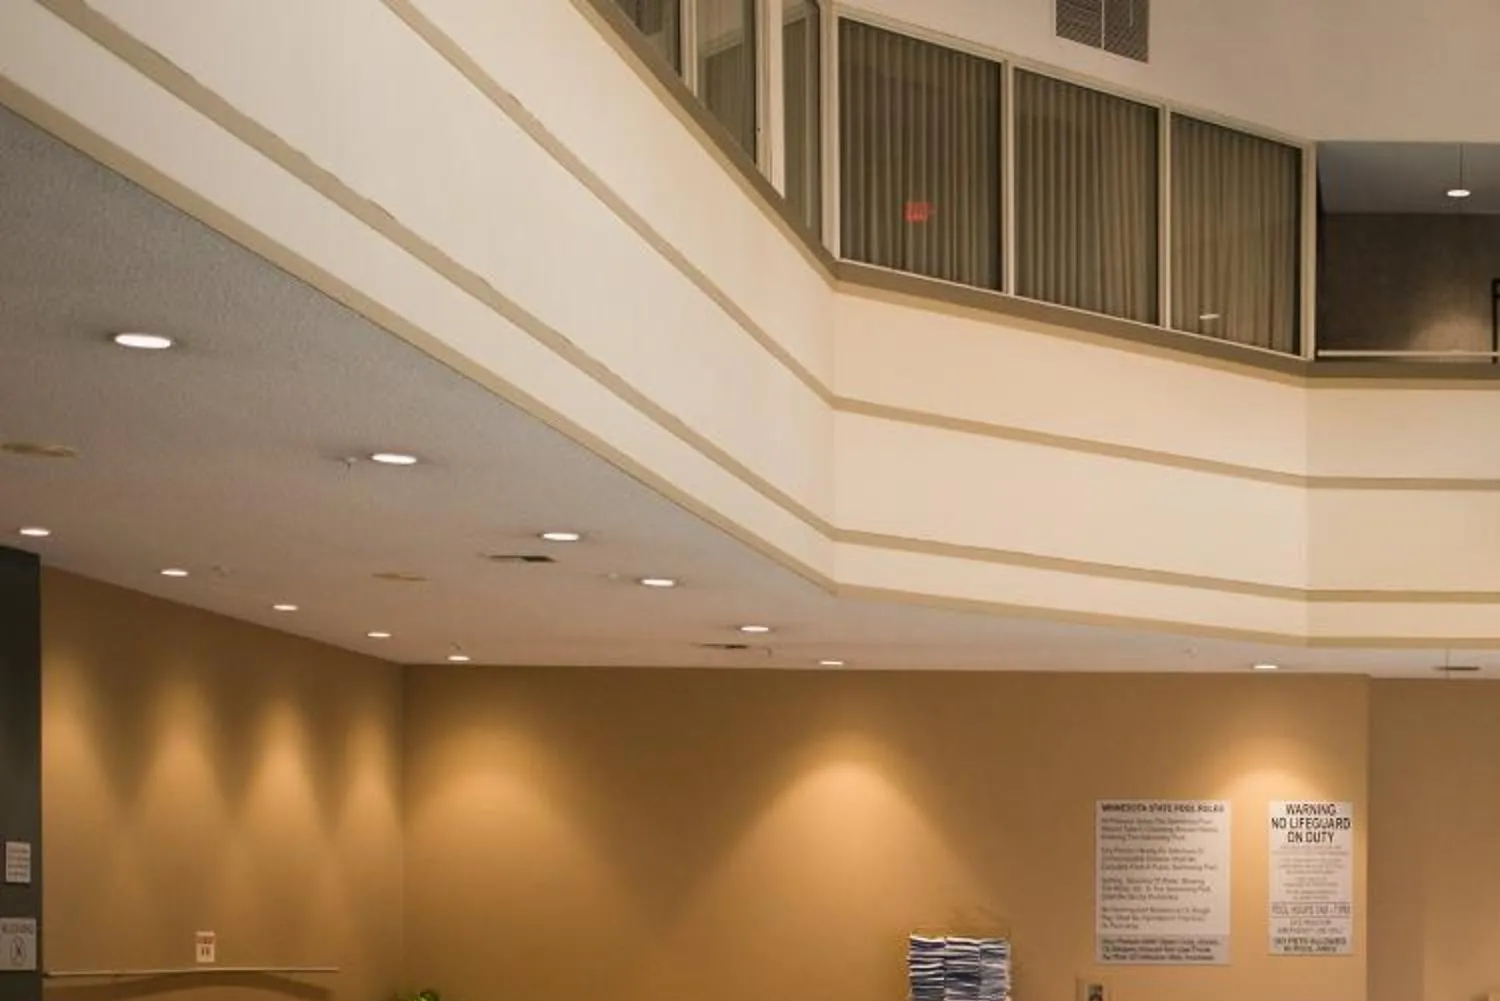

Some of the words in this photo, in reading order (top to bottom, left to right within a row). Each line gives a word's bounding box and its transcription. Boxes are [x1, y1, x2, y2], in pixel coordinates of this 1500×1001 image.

[1101, 803, 1147, 812] MINNESOTA
[1149, 803, 1172, 812] STATE
[1174, 803, 1195, 812] POOL
[1286, 803, 1336, 816] WARNING
[1271, 817, 1287, 829] NO
[1289, 817, 1351, 829] LIFEGUARD
[1287, 832, 1303, 843] ON
[1305, 832, 1335, 843] DUTY
